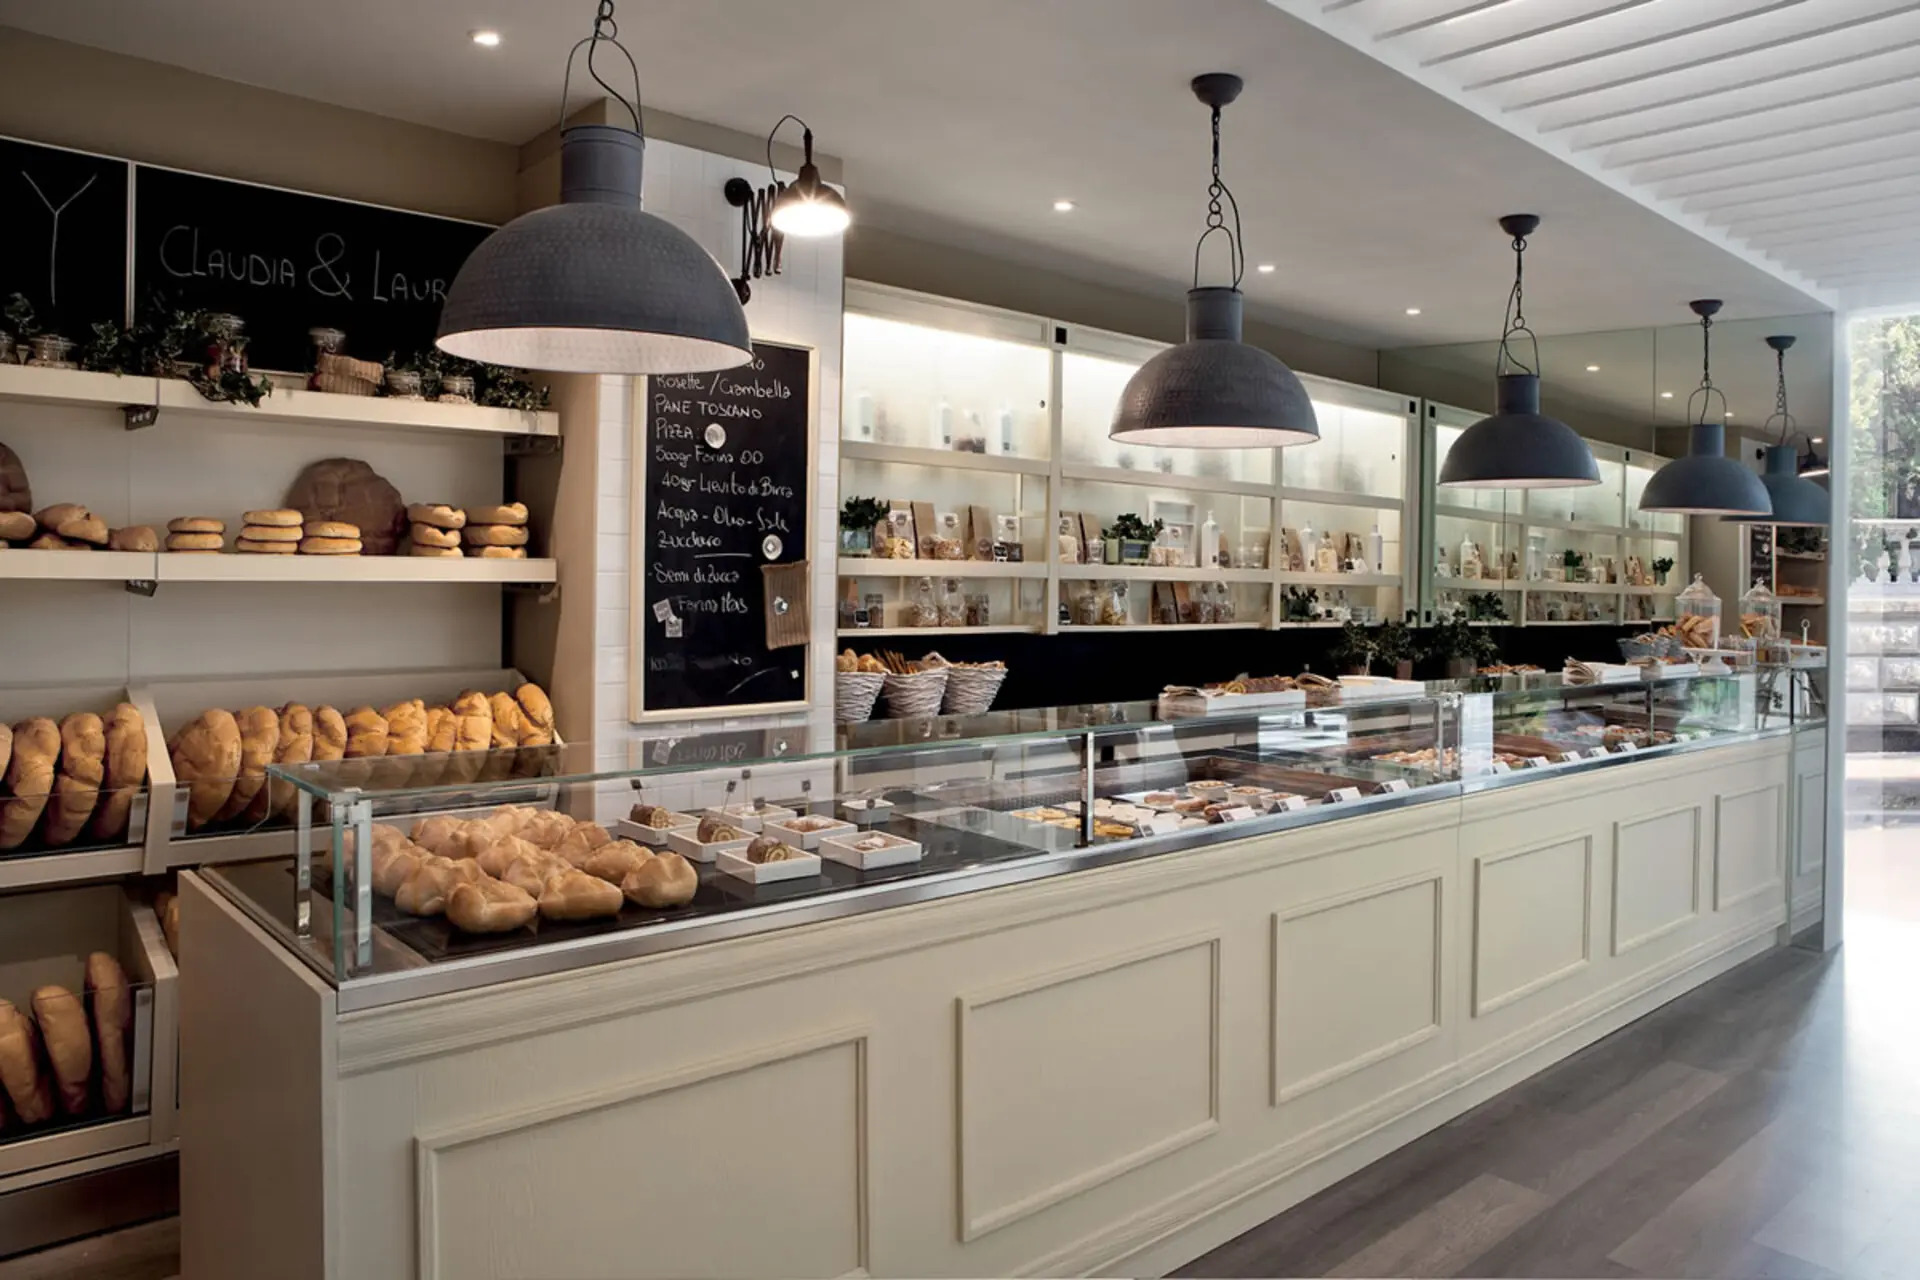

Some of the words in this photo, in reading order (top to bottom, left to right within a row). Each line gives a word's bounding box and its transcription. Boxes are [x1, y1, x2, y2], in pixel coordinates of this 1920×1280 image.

[160, 225, 296, 288] CLAUDIA
[373, 248, 448, 303] LAUR
[655, 393, 692, 415] PANE
